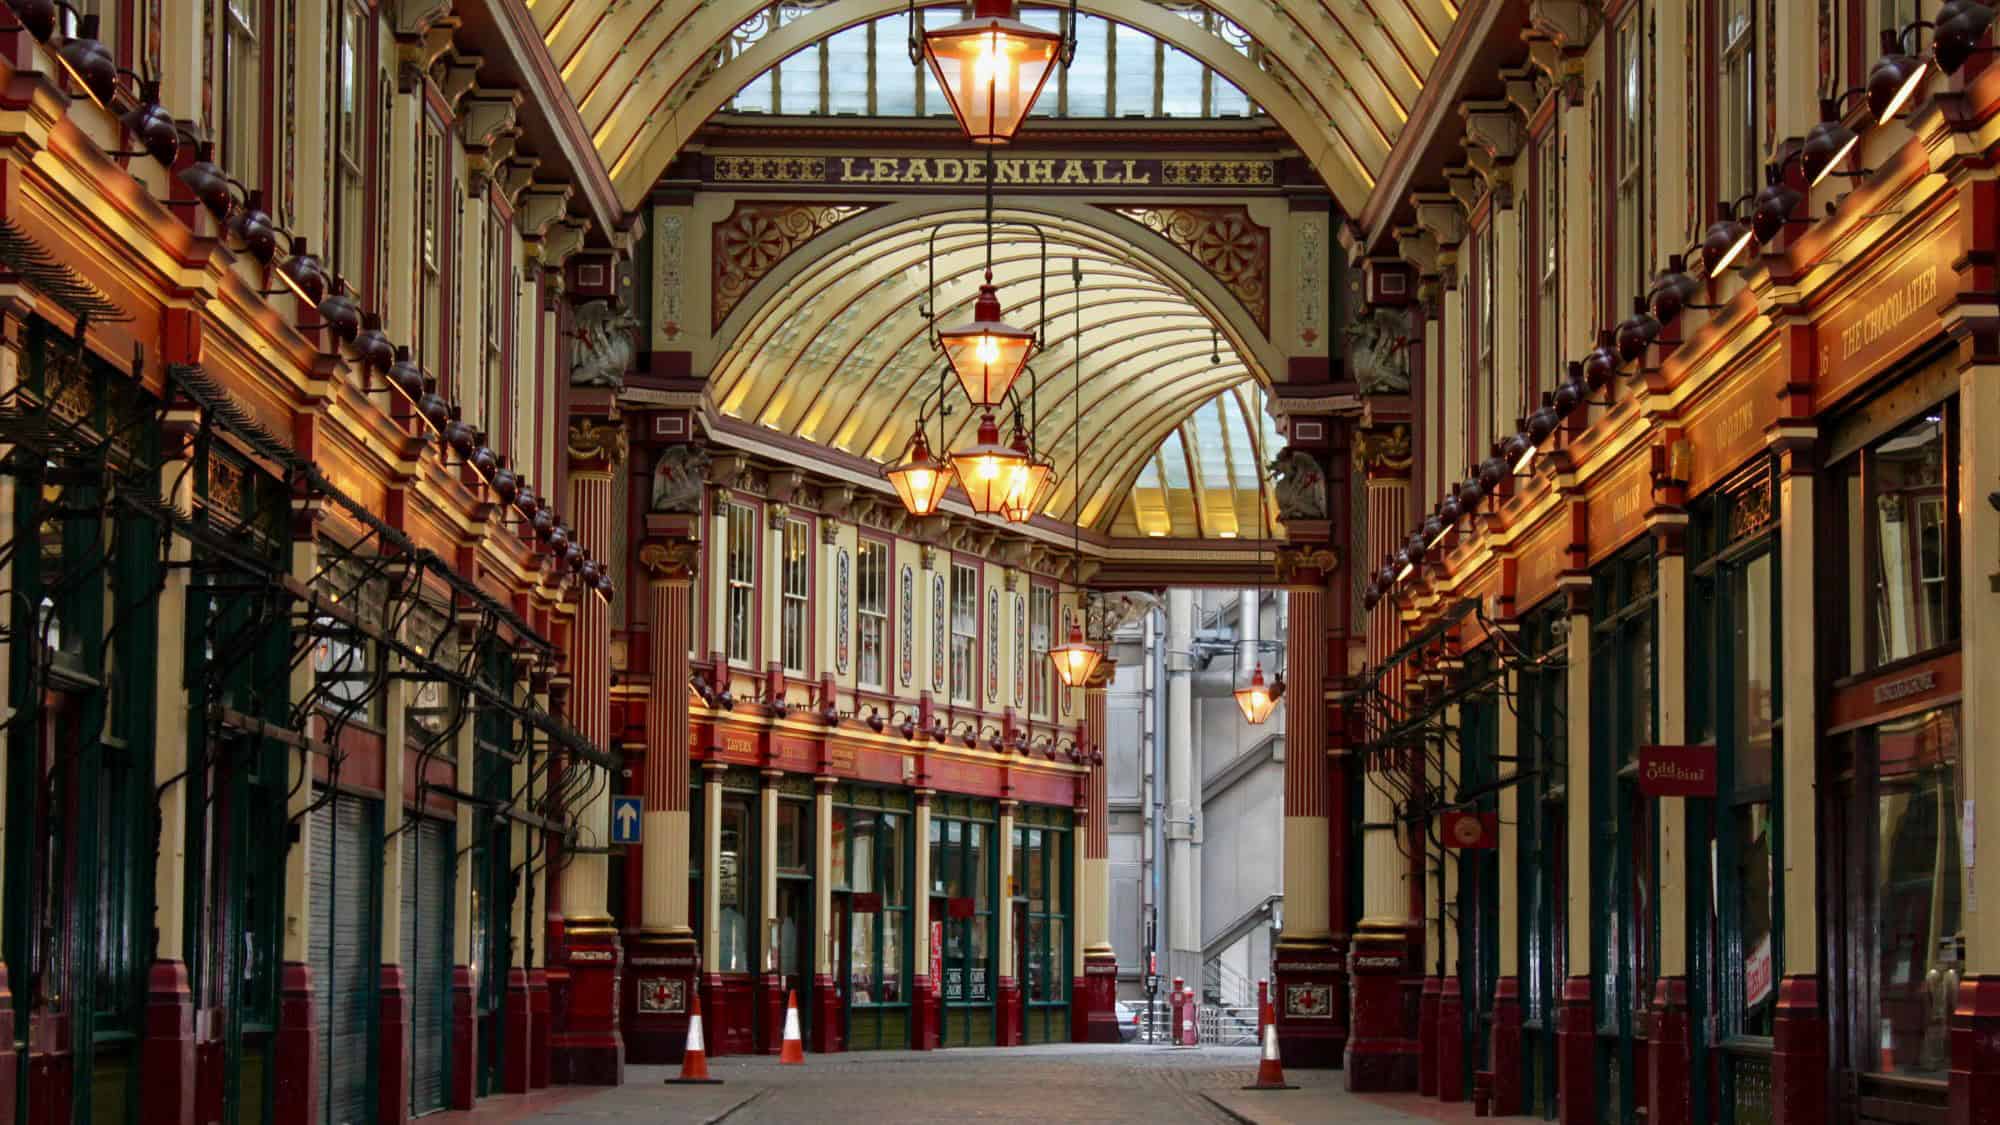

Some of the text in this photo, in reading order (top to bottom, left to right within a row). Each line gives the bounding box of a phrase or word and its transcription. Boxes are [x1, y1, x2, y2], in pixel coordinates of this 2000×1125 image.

[840, 157, 1151, 185] LEADENHALL
[1841, 317, 1864, 361] THE
[1863, 265, 1938, 346] CHOCOLATIER
[726, 737, 753, 753] TAVERN
